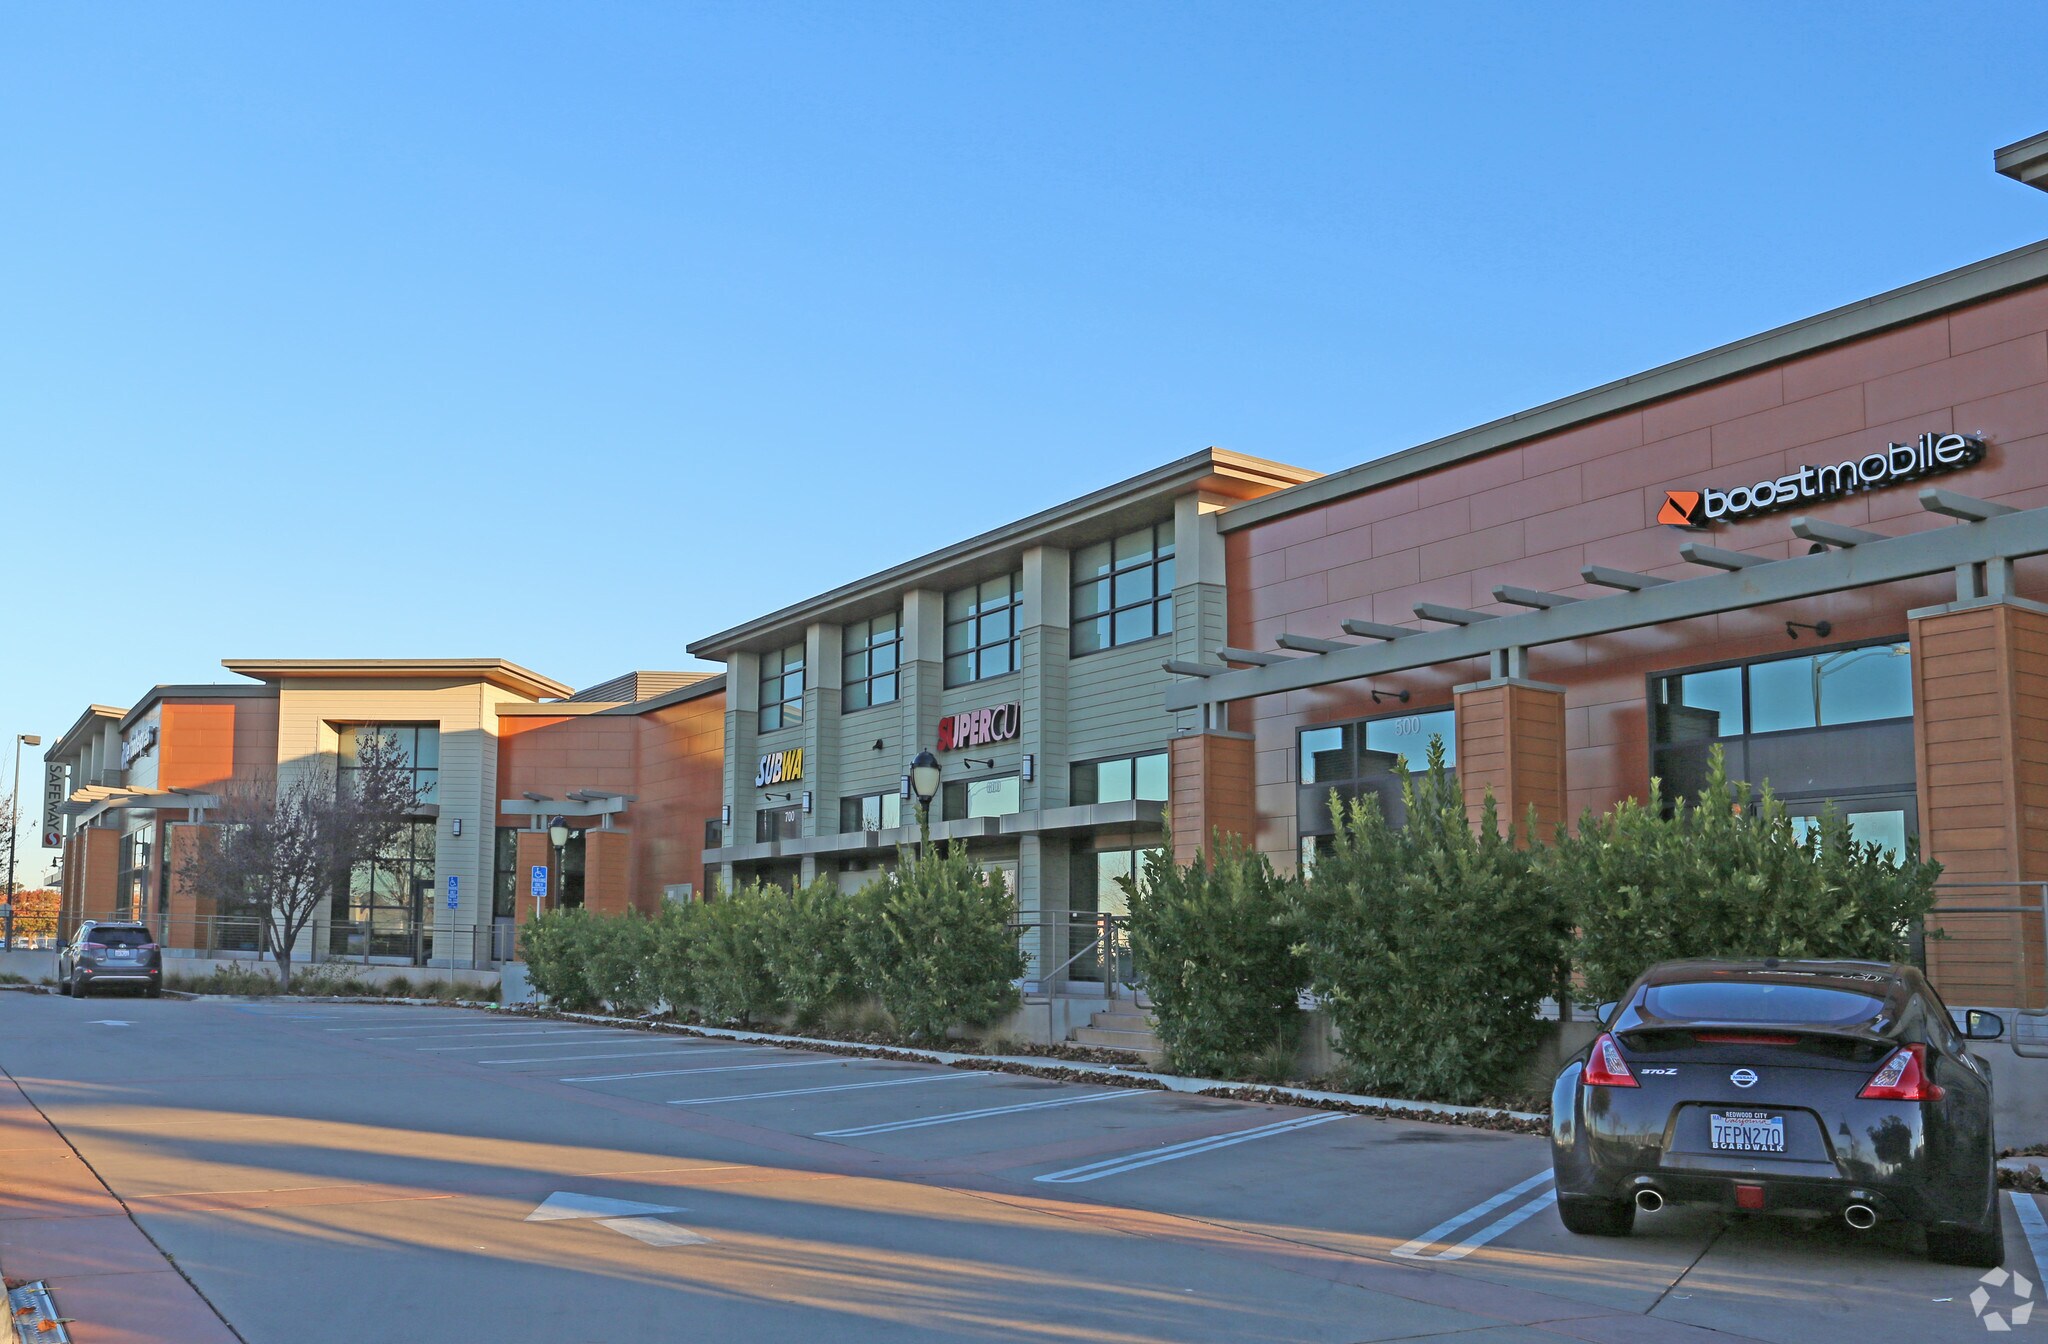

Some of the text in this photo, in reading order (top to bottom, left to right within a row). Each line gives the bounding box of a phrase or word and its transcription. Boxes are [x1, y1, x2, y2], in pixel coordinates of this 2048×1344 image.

[937, 702, 1020, 751] SUPERCU
[1394, 716, 1421, 737] 500
[755, 747, 804, 788] SUBWA
[47, 764, 62, 831] SAFEWAY
[784, 810, 795, 823] 700
[1725, 1111, 1753, 1119] REDWOOD
[1712, 1142, 1784, 1152] BOARDWALK
